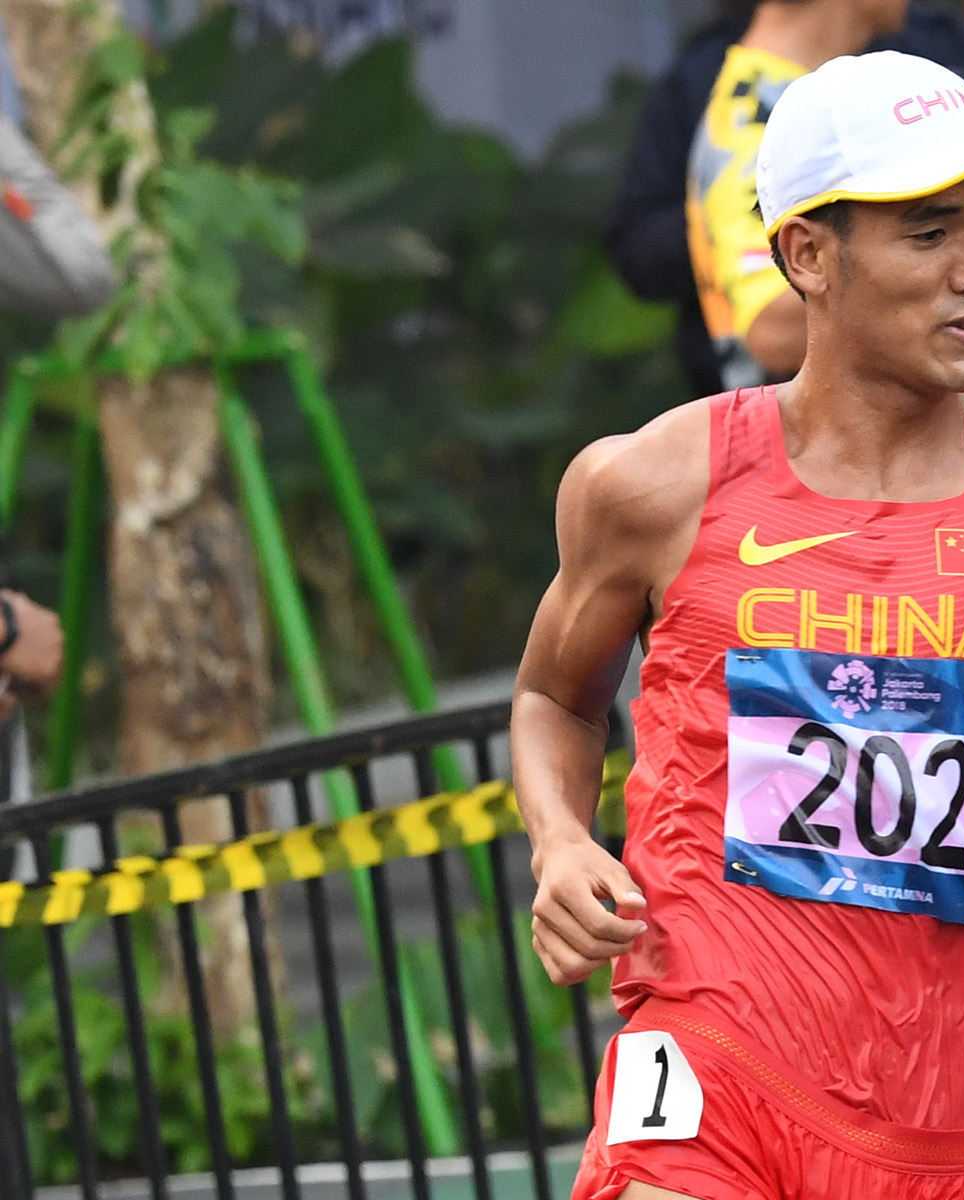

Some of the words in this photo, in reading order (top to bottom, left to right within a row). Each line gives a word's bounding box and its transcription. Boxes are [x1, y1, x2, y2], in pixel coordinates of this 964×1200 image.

[882, 679, 924, 689] Jakarta
[881, 688, 941, 702] Palembang
[881, 700, 906, 711] 2018
[863, 883, 934, 904] PERTAMINA
[642, 1043, 669, 1128] 1
